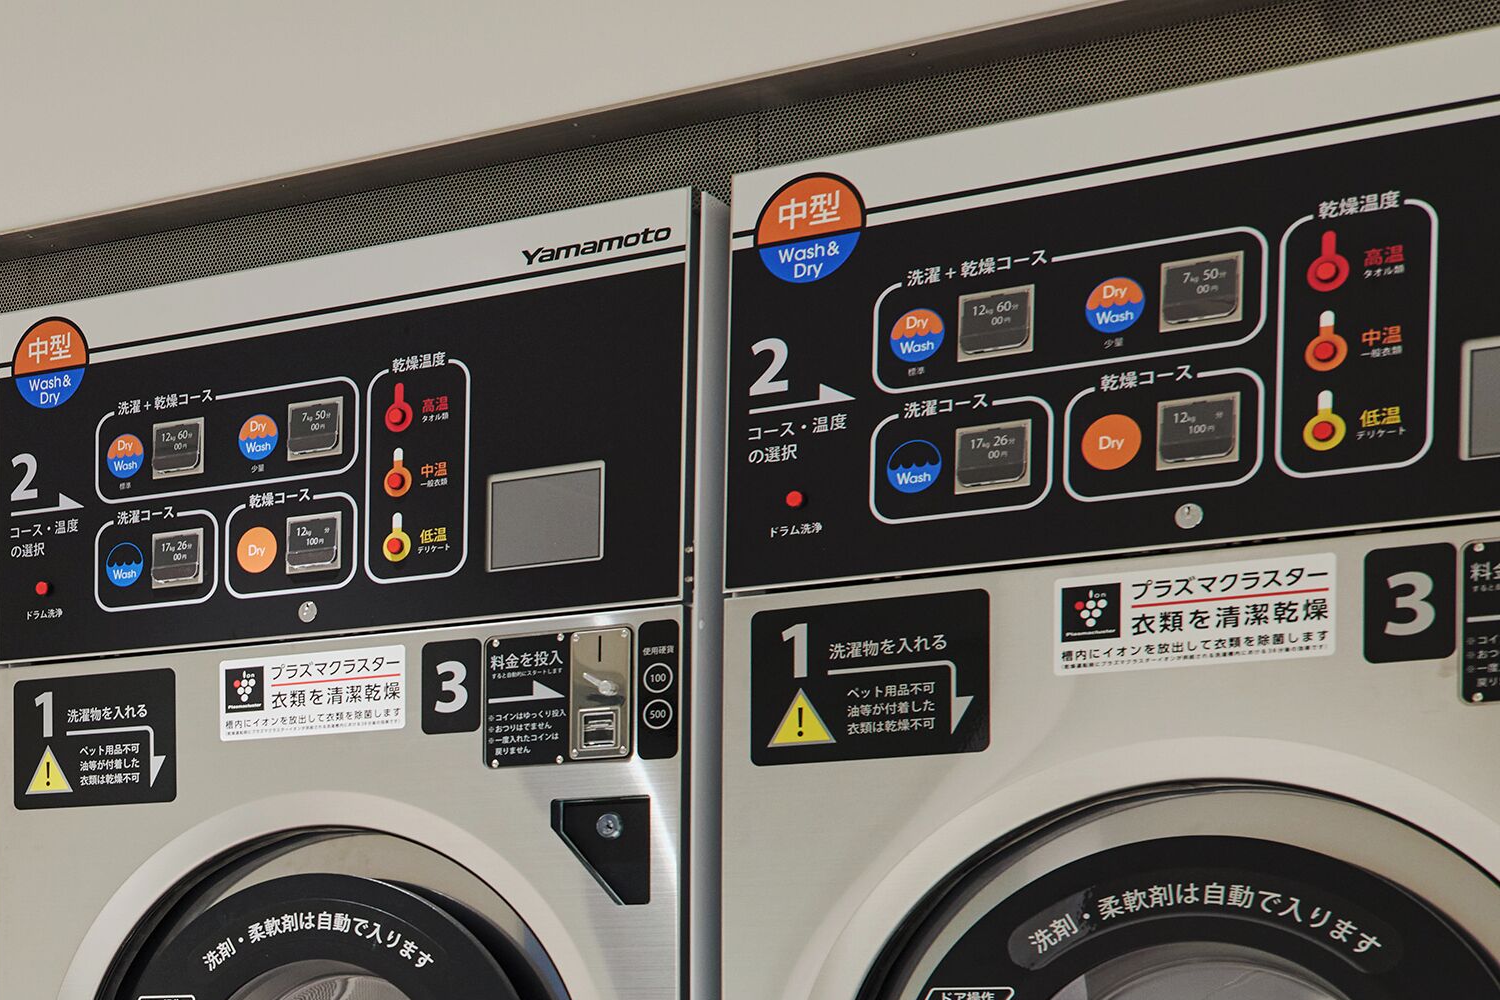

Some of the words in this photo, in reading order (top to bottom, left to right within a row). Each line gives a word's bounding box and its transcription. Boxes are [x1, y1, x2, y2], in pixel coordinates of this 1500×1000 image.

[778, 190, 840, 229] 中型
[1318, 190, 1400, 219] 乾燥温度
[522, 227, 671, 265] Yamamoto
[1363, 245, 1405, 266] 高温
[793, 262, 823, 280] Dry
[1363, 265, 1405, 279] タオル類
[1102, 285, 1128, 300] Dry
[906, 315, 929, 330] Dry
[1096, 310, 1134, 325] Wash
[1361, 326, 1403, 346] 中温
[28, 333, 71, 364] 中型
[900, 340, 935, 354] Wash
[1360, 345, 1403, 359] 一般衣類
[392, 351, 446, 373] 乾燥温度
[749, 338, 789, 396] 2
[1100, 365, 1193, 392] 乾燥コース
[40, 391, 60, 405] Dry
[422, 396, 449, 413] 高温
[903, 394, 989, 419] 洗濯コース
[1359, 406, 1401, 427] 低温
[250, 420, 266, 434] Dry
[748, 413, 848, 441] コース・温度
[1355, 426, 1406, 440] デリケート
[117, 440, 133, 451] Dry
[245, 441, 271, 453] Wash
[1098, 436, 1124, 450] Dry
[748, 444, 798, 465] の選択
[113, 460, 138, 471] Wash
[420, 462, 448, 478] 中温
[10, 453, 38, 501] 2
[896, 471, 931, 485] Wash
[249, 488, 312, 508] 乾燥コース
[117, 506, 175, 525] 洗濯コース
[10, 518, 79, 539] コース・温度
[420, 527, 447, 544] 低温
[770, 522, 823, 538] ドラム洗浄
[10, 543, 45, 559] の選択
[248, 544, 266, 557] Dry
[112, 569, 137, 580] Wash
[1132, 567, 1329, 600] プラズマクラスター
[1384, 571, 1436, 636] 3
[26, 608, 63, 620] ドラム洗浄
[1132, 598, 1329, 636] 衣類を清潔乾燥
[642, 645, 675, 656] 使用硬貨
[781, 622, 808, 679] 1
[829, 633, 947, 660] 洗濯物を入れる
[1061, 630, 1329, 662] 槽内にイオンを放出して衣類を除菌します
[271, 657, 400, 680] プラズマクラスター
[490, 650, 563, 670] 料金を投入
[491, 668, 562, 680] すると自動的にスタートします
[650, 673, 666, 683] 100
[272, 682, 401, 709] 衣類を清潔乾燥
[434, 661, 468, 713] 3
[847, 681, 936, 698] ペット用品不可
[34, 691, 53, 738] 1
[67, 704, 148, 723] 洗濯物を入れる
[650, 709, 666, 719] 500
[847, 699, 935, 717] 油等が付着した
[847, 717, 936, 735] 衣類は乾燥不可
[80, 743, 140, 756] ペット用品不可
[495, 746, 531, 756] 戻りません
[80, 758, 140, 771] 油等が付着した
[80, 773, 140, 786] 衣類は乾燥不可
[1029, 882, 1382, 954] 洗剤・柔軟剤は自動で入ります
[202, 911, 434, 972] 洗剤・柔軟剤は自動で入ります
